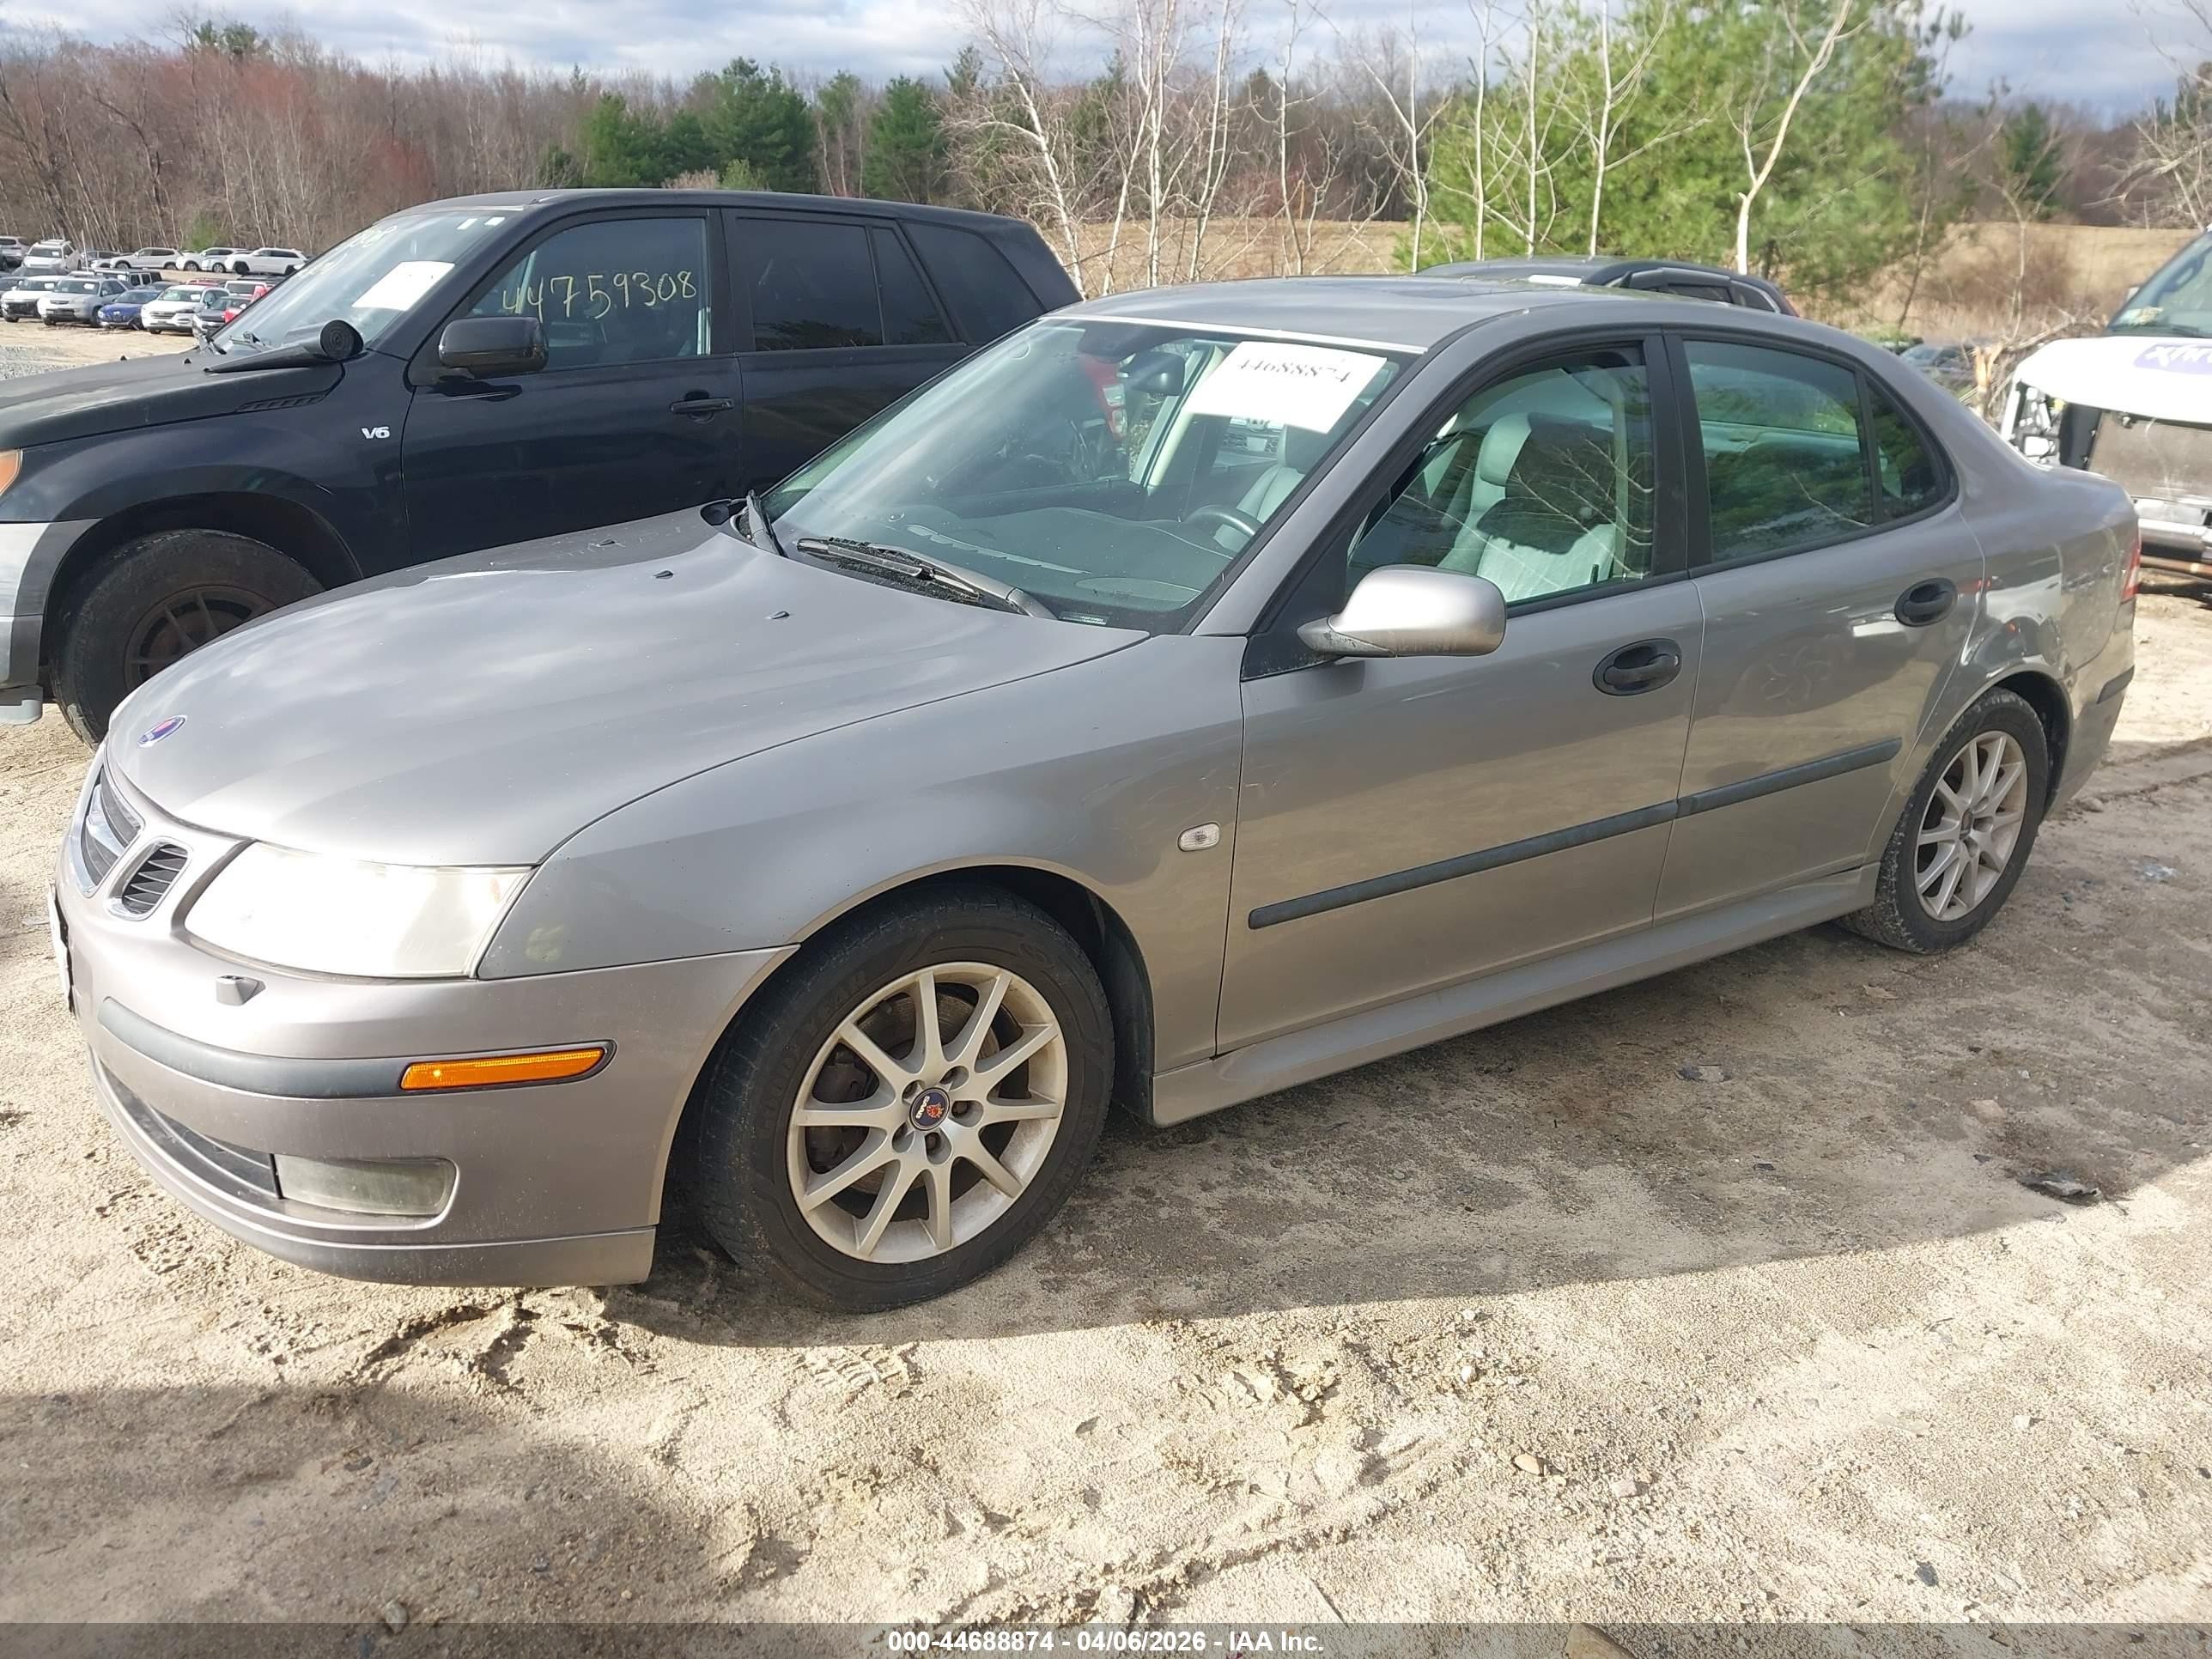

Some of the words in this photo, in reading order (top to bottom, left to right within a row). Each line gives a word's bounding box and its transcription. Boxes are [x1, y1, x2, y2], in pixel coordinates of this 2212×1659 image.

[502, 270, 697, 323] 44759308
[361, 426, 390, 440] V6
[915, 1096, 931, 1119] SAAB
